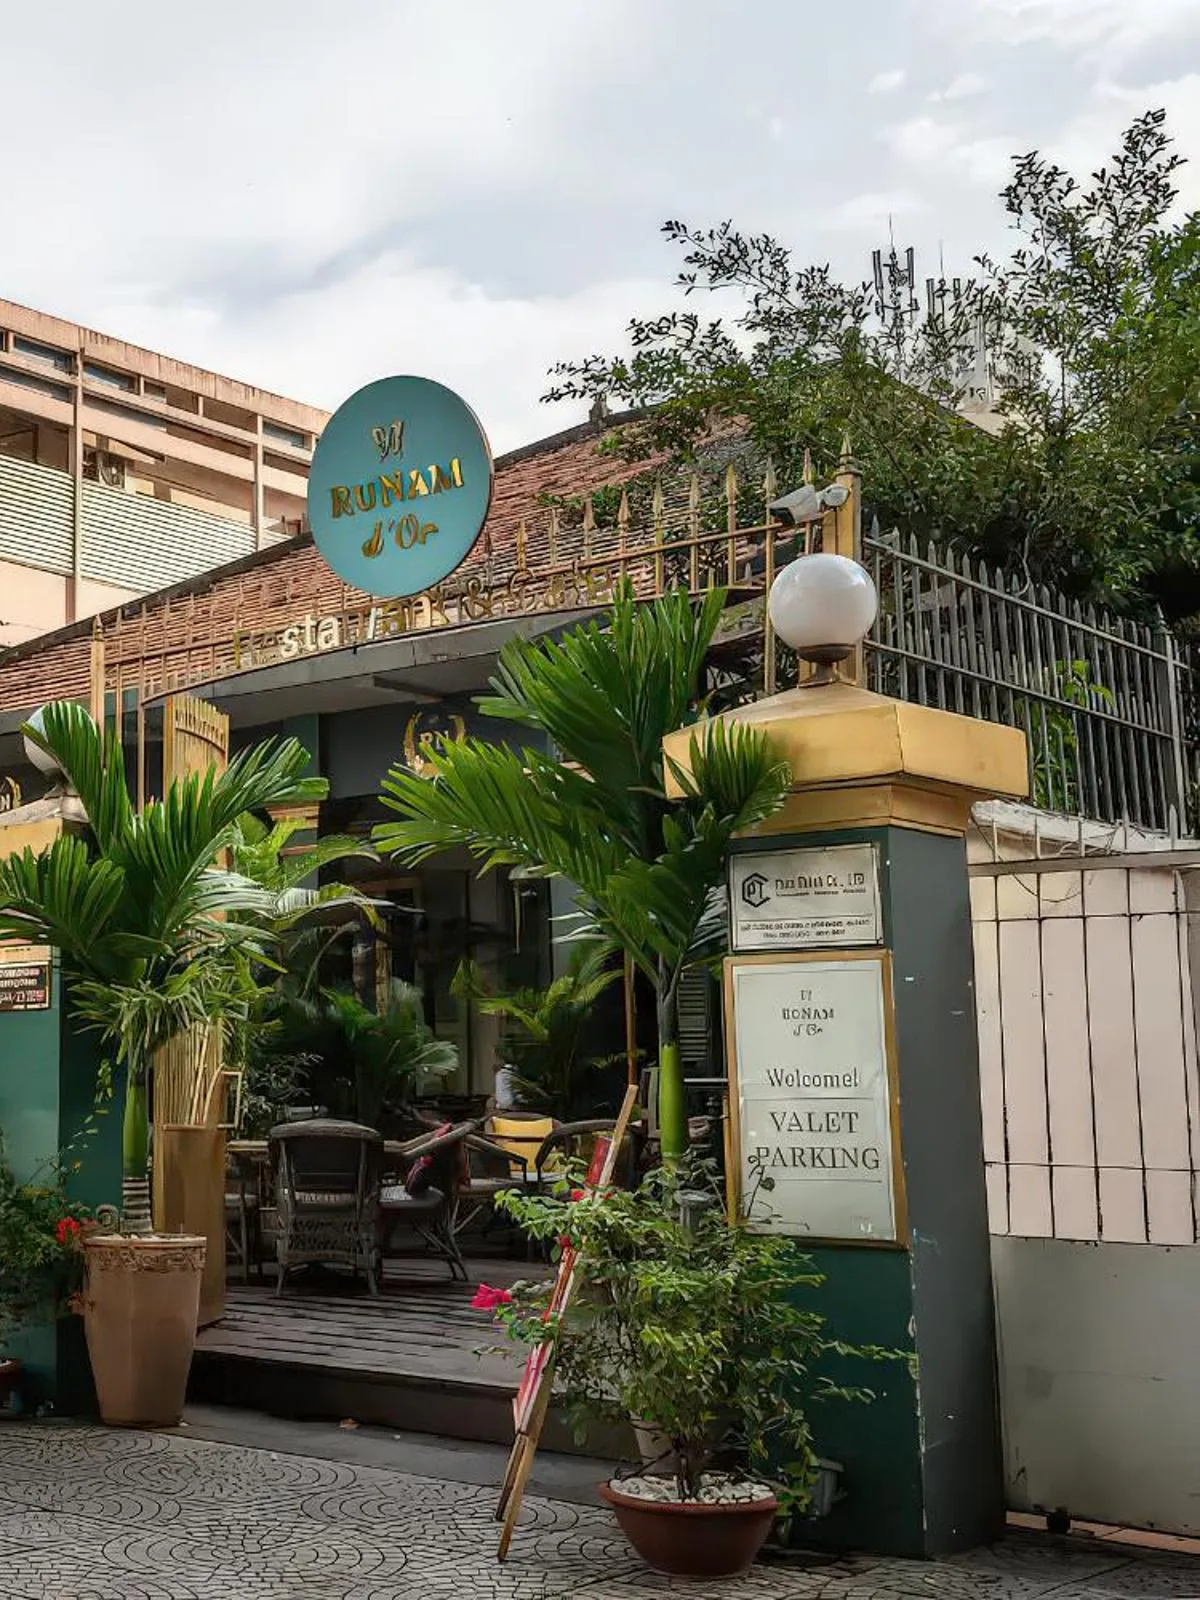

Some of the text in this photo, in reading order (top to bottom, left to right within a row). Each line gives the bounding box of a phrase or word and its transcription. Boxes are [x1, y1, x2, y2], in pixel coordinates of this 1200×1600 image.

[330, 457, 464, 518] RUNAM
[770, 1112, 859, 1134] VALET
[755, 1145, 880, 1170] PARKING
